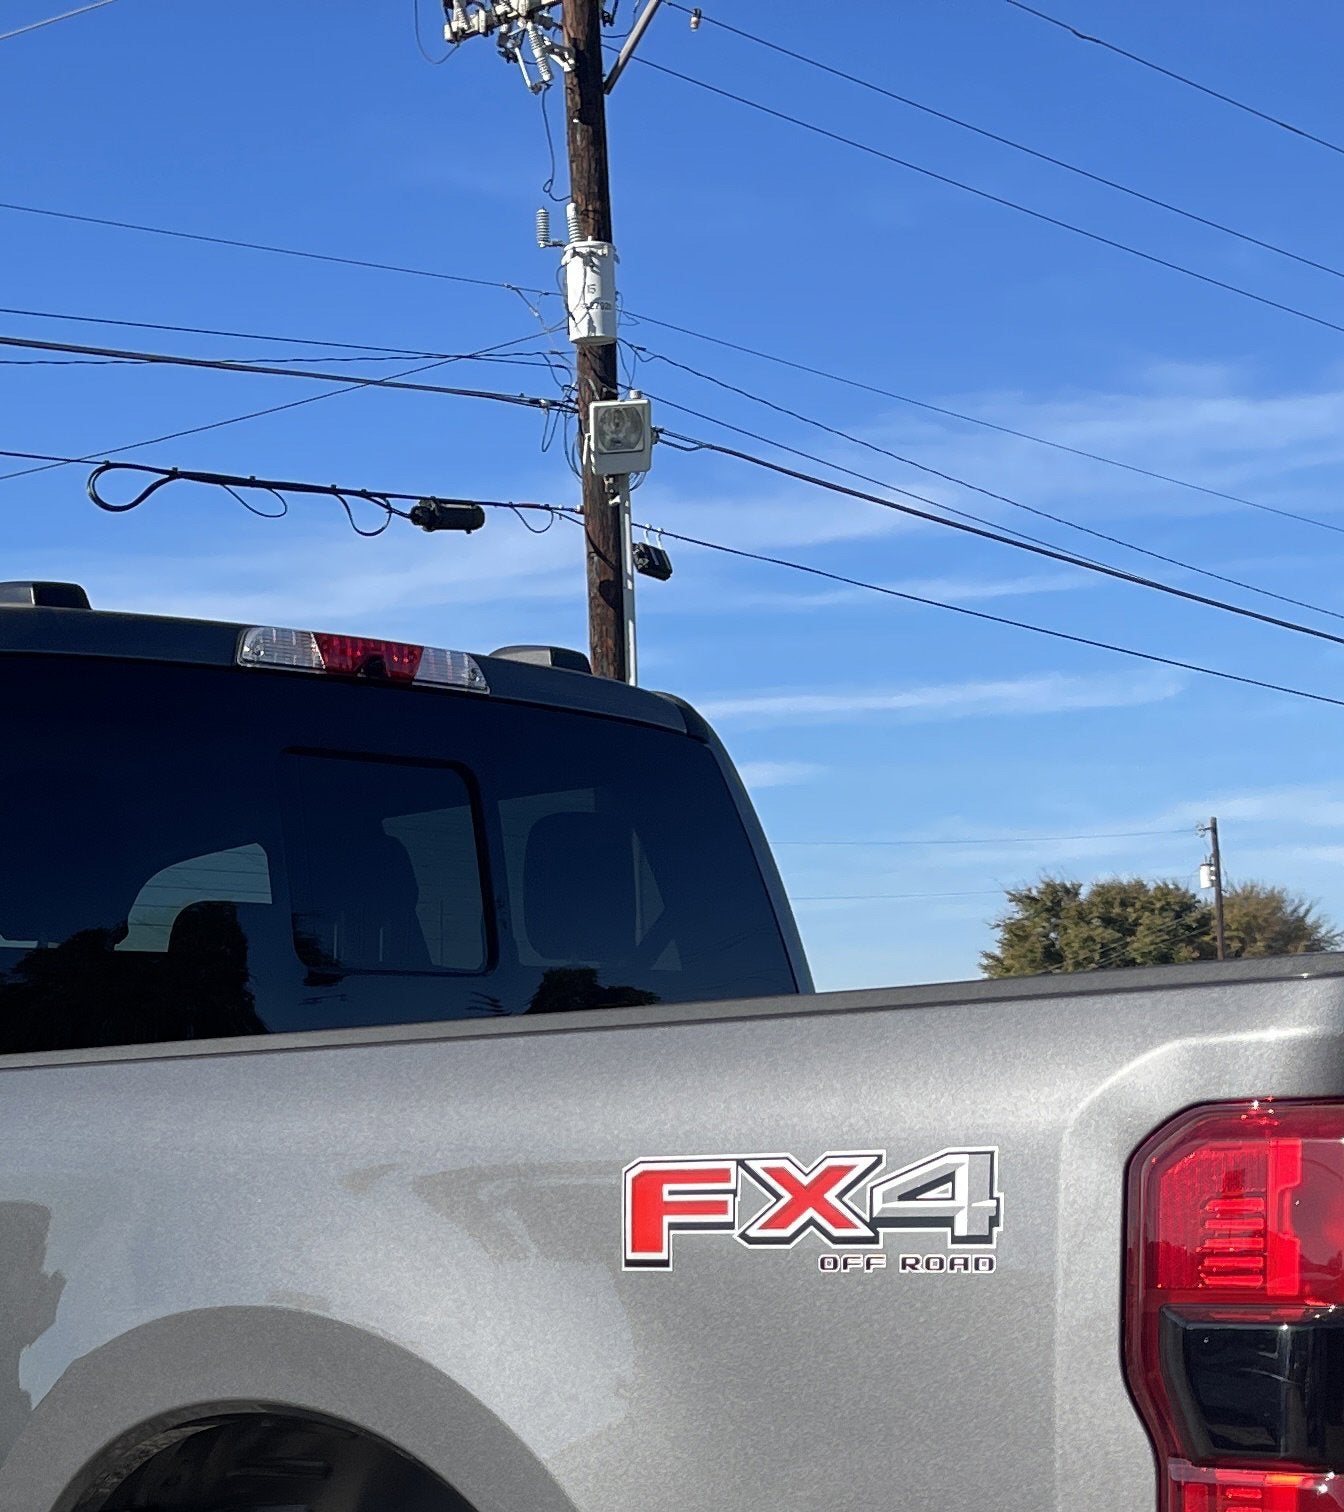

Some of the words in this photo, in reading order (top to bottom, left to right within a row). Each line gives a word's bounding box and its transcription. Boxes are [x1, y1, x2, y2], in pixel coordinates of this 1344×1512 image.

[622, 1146, 1004, 1271] FX4
[818, 1253, 887, 1272] OFF
[899, 1253, 998, 1272] ROAD
